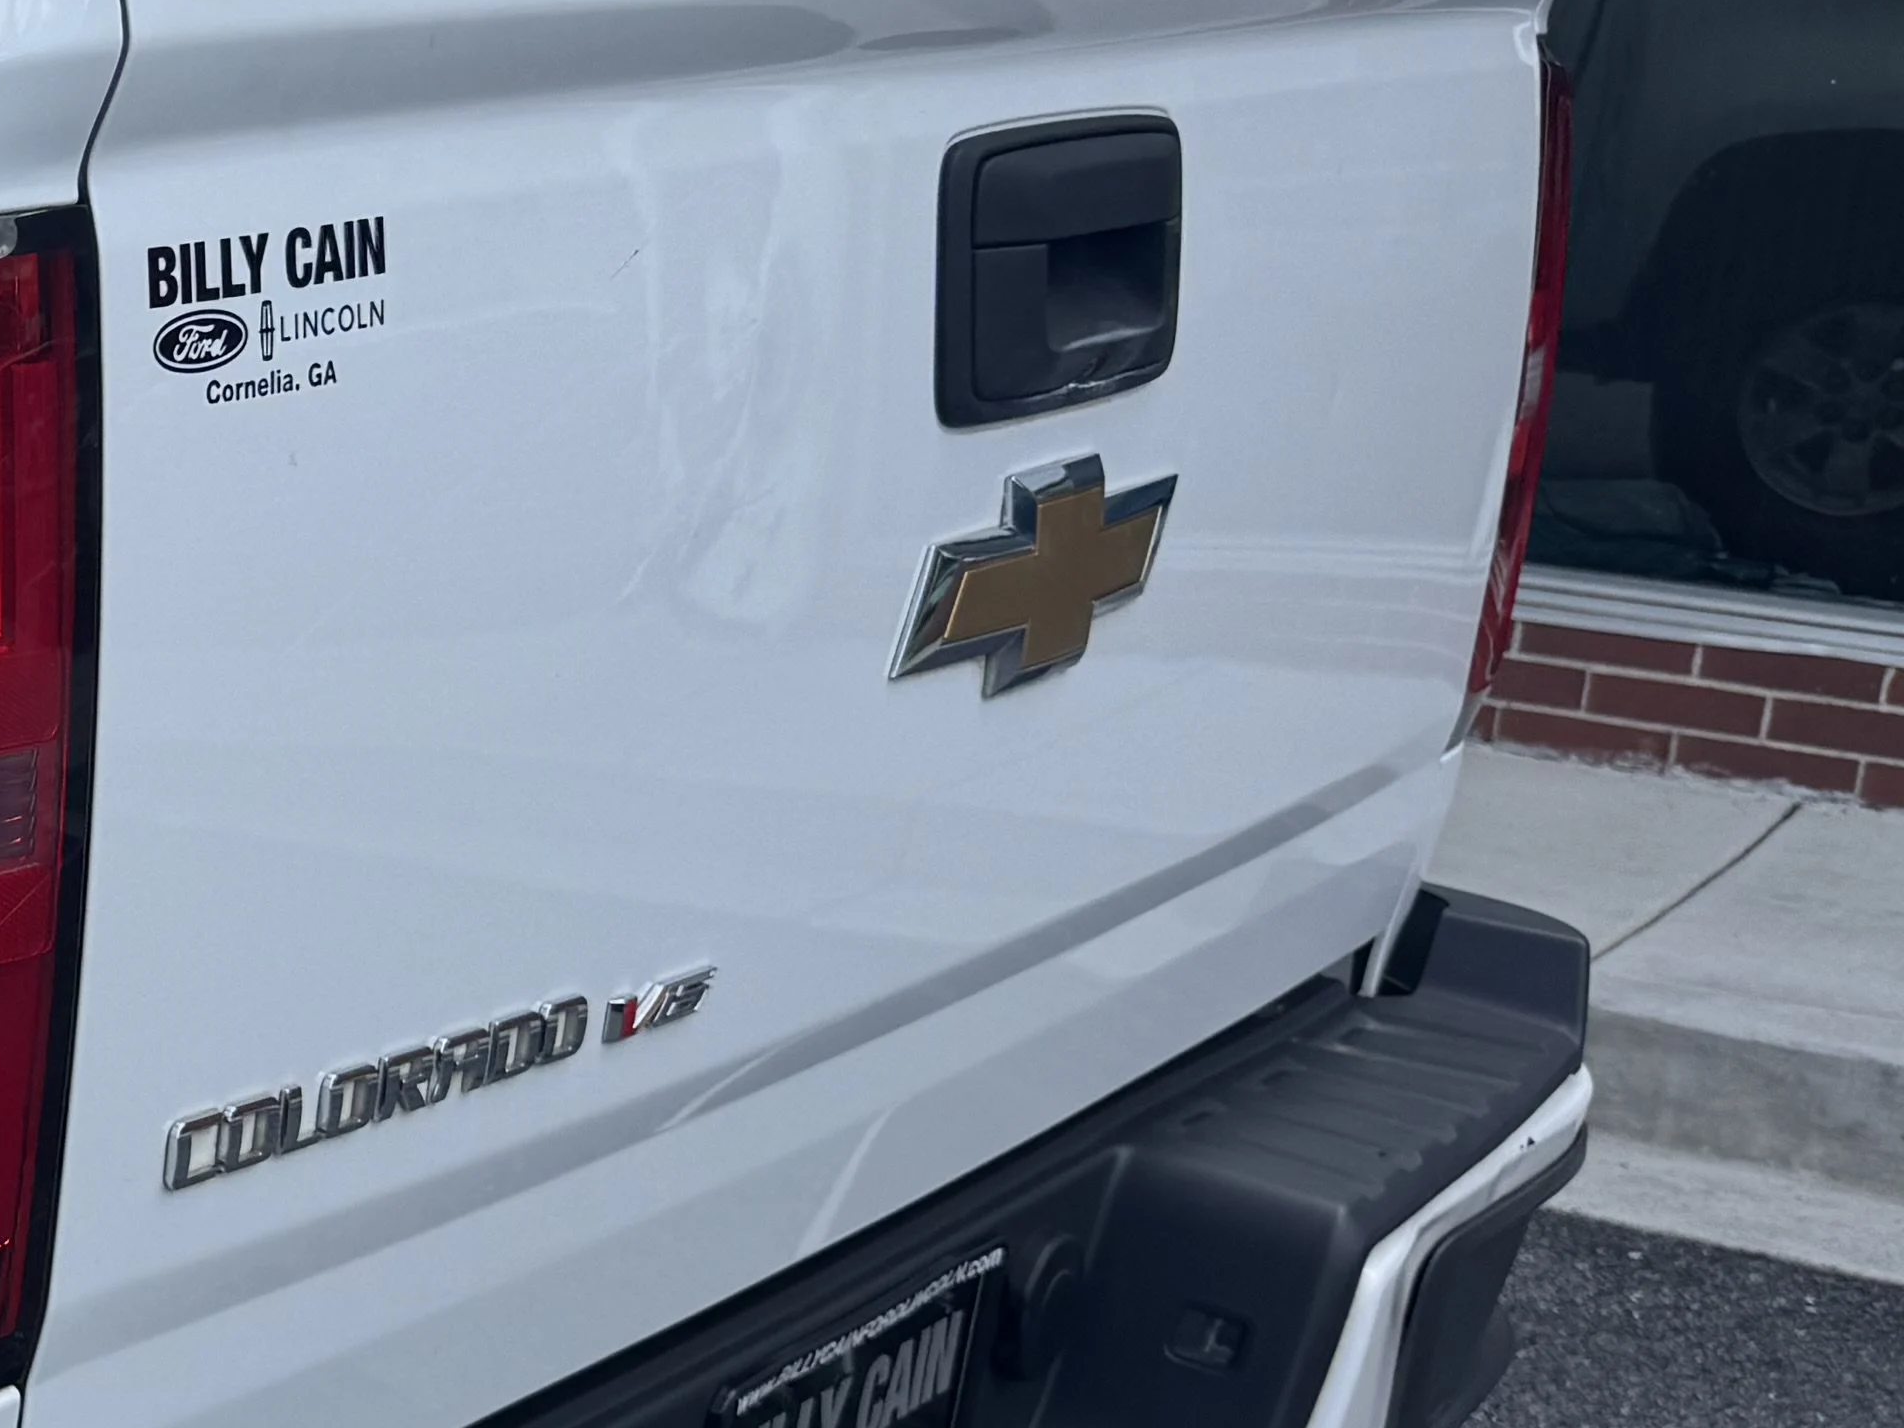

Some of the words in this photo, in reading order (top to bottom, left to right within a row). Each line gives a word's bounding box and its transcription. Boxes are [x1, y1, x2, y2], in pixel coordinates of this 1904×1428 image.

[147, 232, 269, 309] BILLY
[285, 216, 386, 288] CAIN
[172, 324, 228, 362] Ford
[280, 299, 384, 342] LINCOLN
[308, 360, 337, 387] GA
[164, 995, 588, 1192] COLORADO
